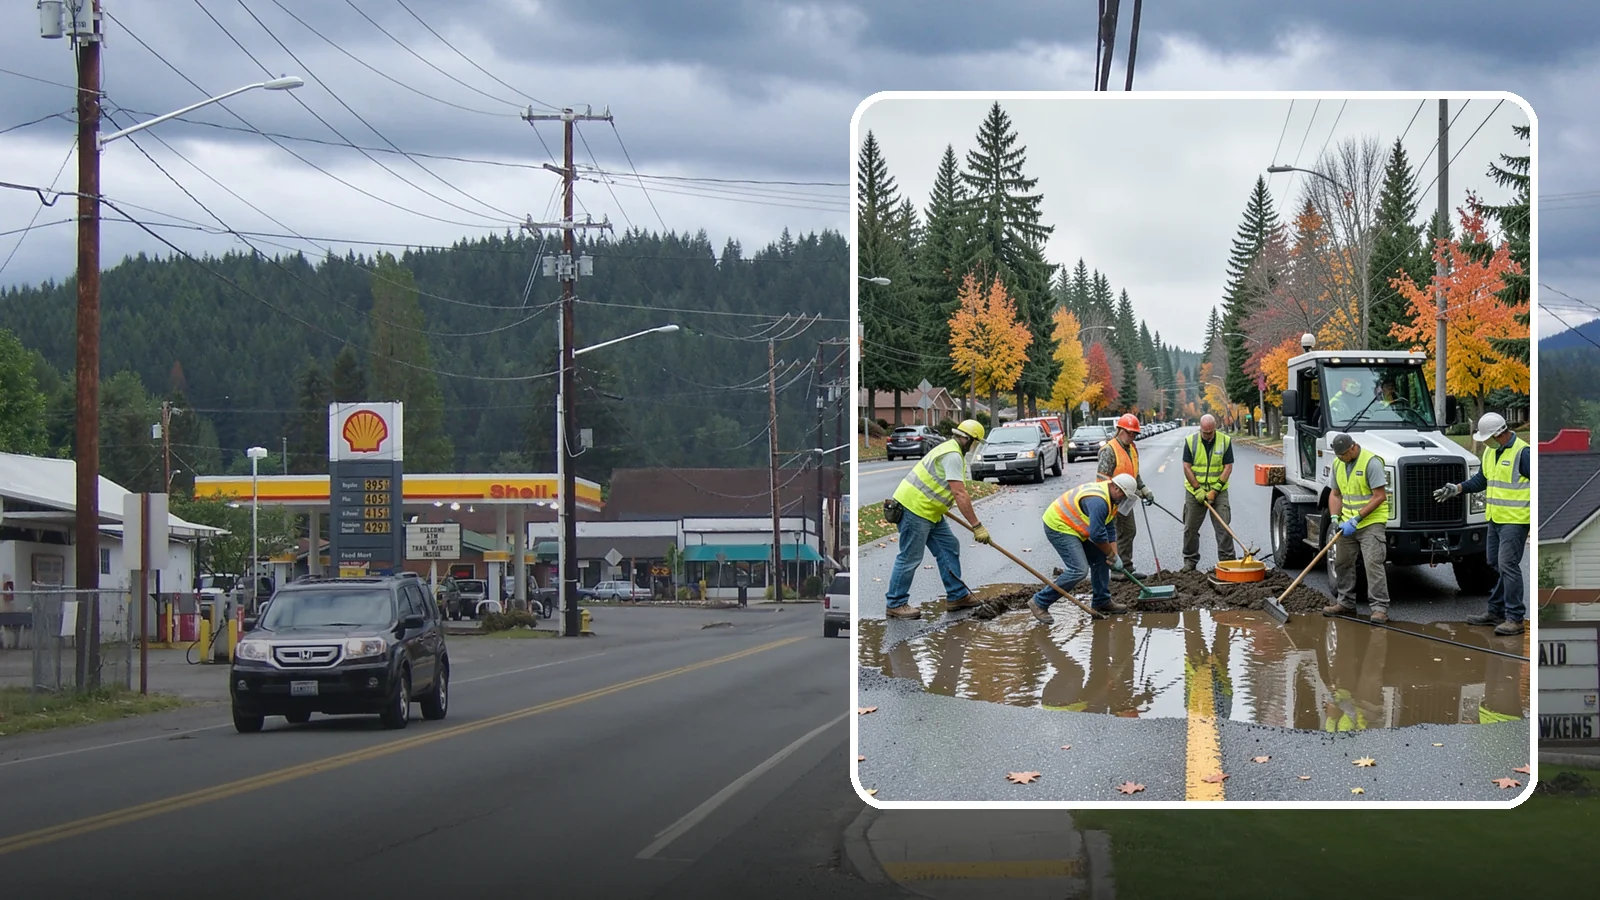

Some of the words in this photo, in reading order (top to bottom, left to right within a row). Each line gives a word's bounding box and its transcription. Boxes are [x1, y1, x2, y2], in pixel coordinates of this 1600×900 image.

[366, 480, 383, 490] 395
[490, 484, 547, 499] Shell
[366, 494, 383, 504] 405
[366, 508, 383, 518] 415
[366, 522, 383, 533] 429
[1538, 643, 1566, 665] AID
